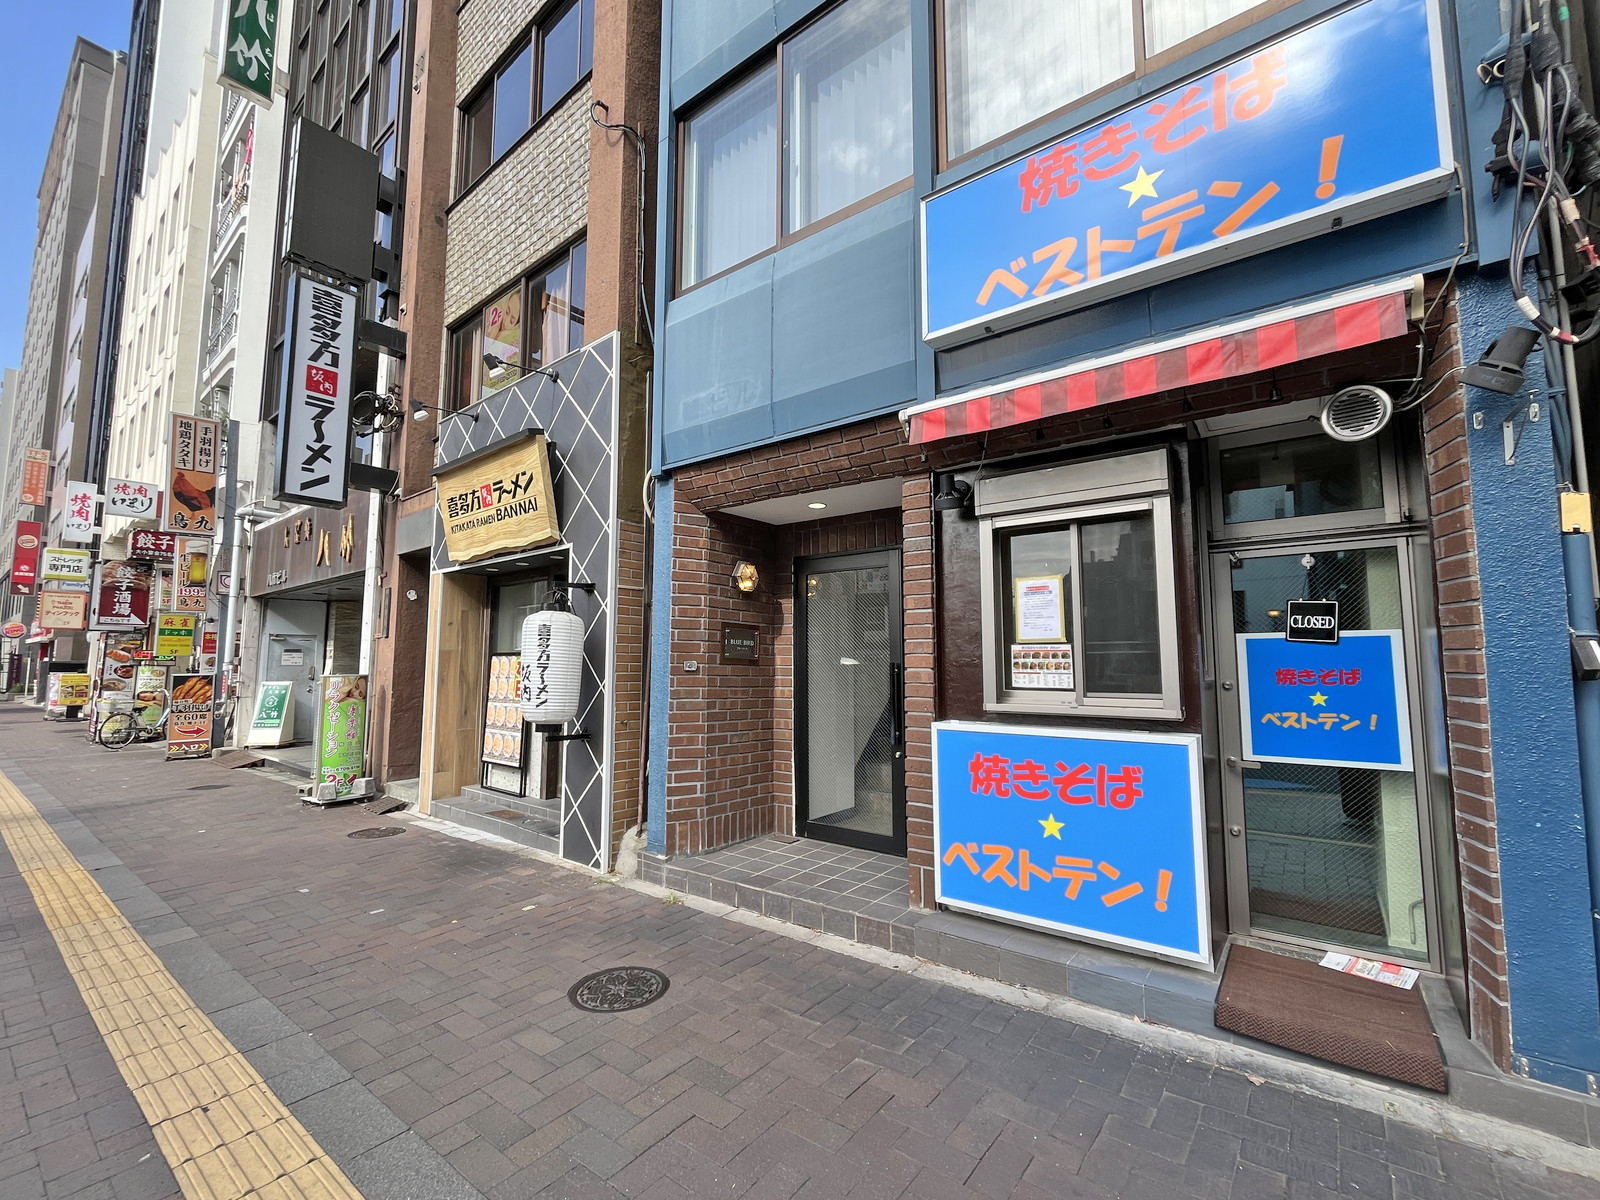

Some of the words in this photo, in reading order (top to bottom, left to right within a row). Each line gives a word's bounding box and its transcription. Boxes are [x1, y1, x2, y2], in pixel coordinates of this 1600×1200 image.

[1018, 44, 1288, 213] 焼きそば
[308, 286, 344, 369] 喜多方
[178, 420, 192, 468] 地鶏タタキ
[198, 426, 213, 468] 手羽揚げ
[300, 394, 336, 492] ラーメン
[70, 492, 92, 521] 焼肉
[113, 482, 148, 498] 焼肉
[447, 489, 482, 519] 喜多方
[492, 470, 534, 504] ラーメン
[450, 519, 477, 535] KITAKATA
[476, 514, 496, 529] RAMEN
[495, 497, 538, 522] BANNAI
[136, 532, 174, 550] 餃子
[48, 564, 83, 573] 専門店
[50, 556, 84, 564] ストレッチ
[179, 553, 191, 587] 生ビール
[112, 565, 136, 616] 餃子酒場
[1290, 615, 1335, 629] CLOSED
[730, 638, 743, 646] BLUE
[1275, 667, 1362, 687] 焼きそば
[174, 713, 208, 721] 全60席
[324, 680, 343, 759] リラクゼーション
[1261, 711, 1378, 731] ベストテン！
[180, 743, 199, 751] 入口
[969, 752, 1143, 810] 焼きそば
[943, 841, 1173, 912] ベストテン！
